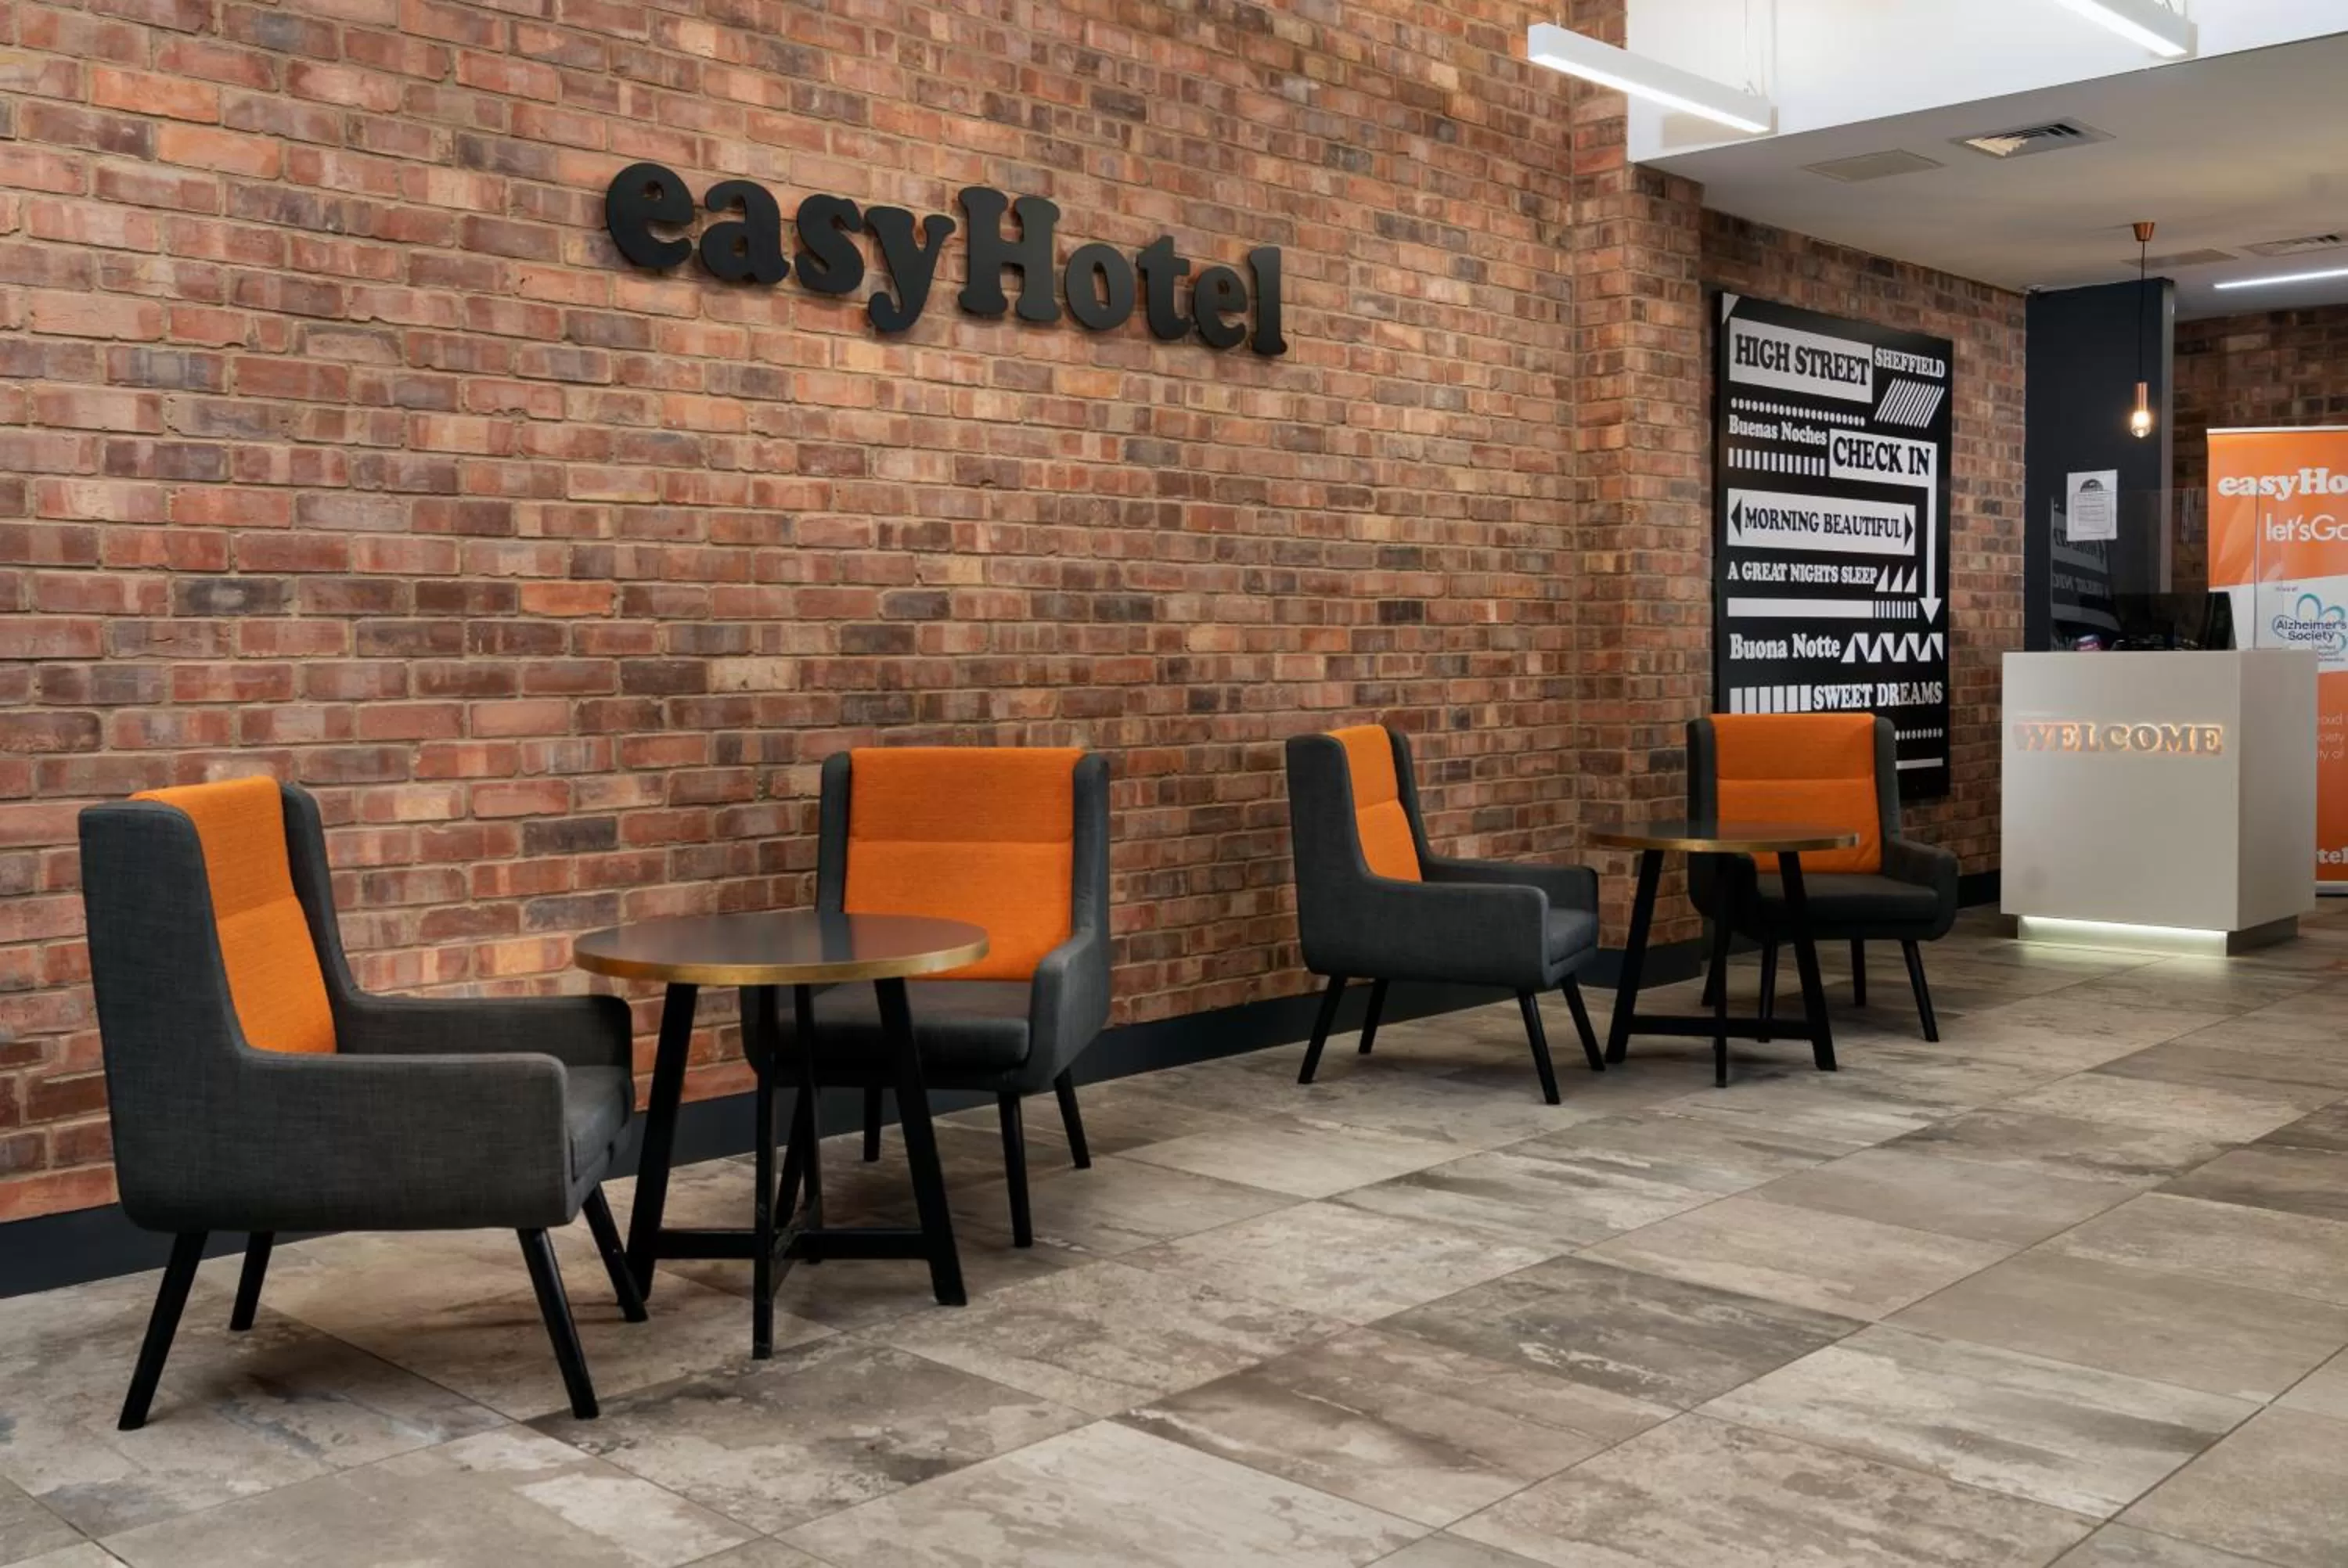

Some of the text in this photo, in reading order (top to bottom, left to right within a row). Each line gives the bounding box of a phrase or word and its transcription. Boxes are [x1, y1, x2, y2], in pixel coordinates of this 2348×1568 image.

[606, 162, 1288, 356] easyHotel
[1735, 334, 1869, 385] HIGH STREET
[1874, 347, 1946, 378] SHEFFIELD
[1728, 415, 1828, 445] Buenas Noches
[1833, 437, 1930, 476] CHECK IN
[1745, 507, 1902, 538] MORNING BEAUTIFUL
[1727, 561, 1877, 584] A GREAT NIGHTS SLEEP
[1730, 633, 1841, 660] Buona Notte
[2288, 631, 2335, 642] Society
[1813, 682, 1943, 710] SWEET DREAMS
[2013, 722, 2223, 756] WELCOME
